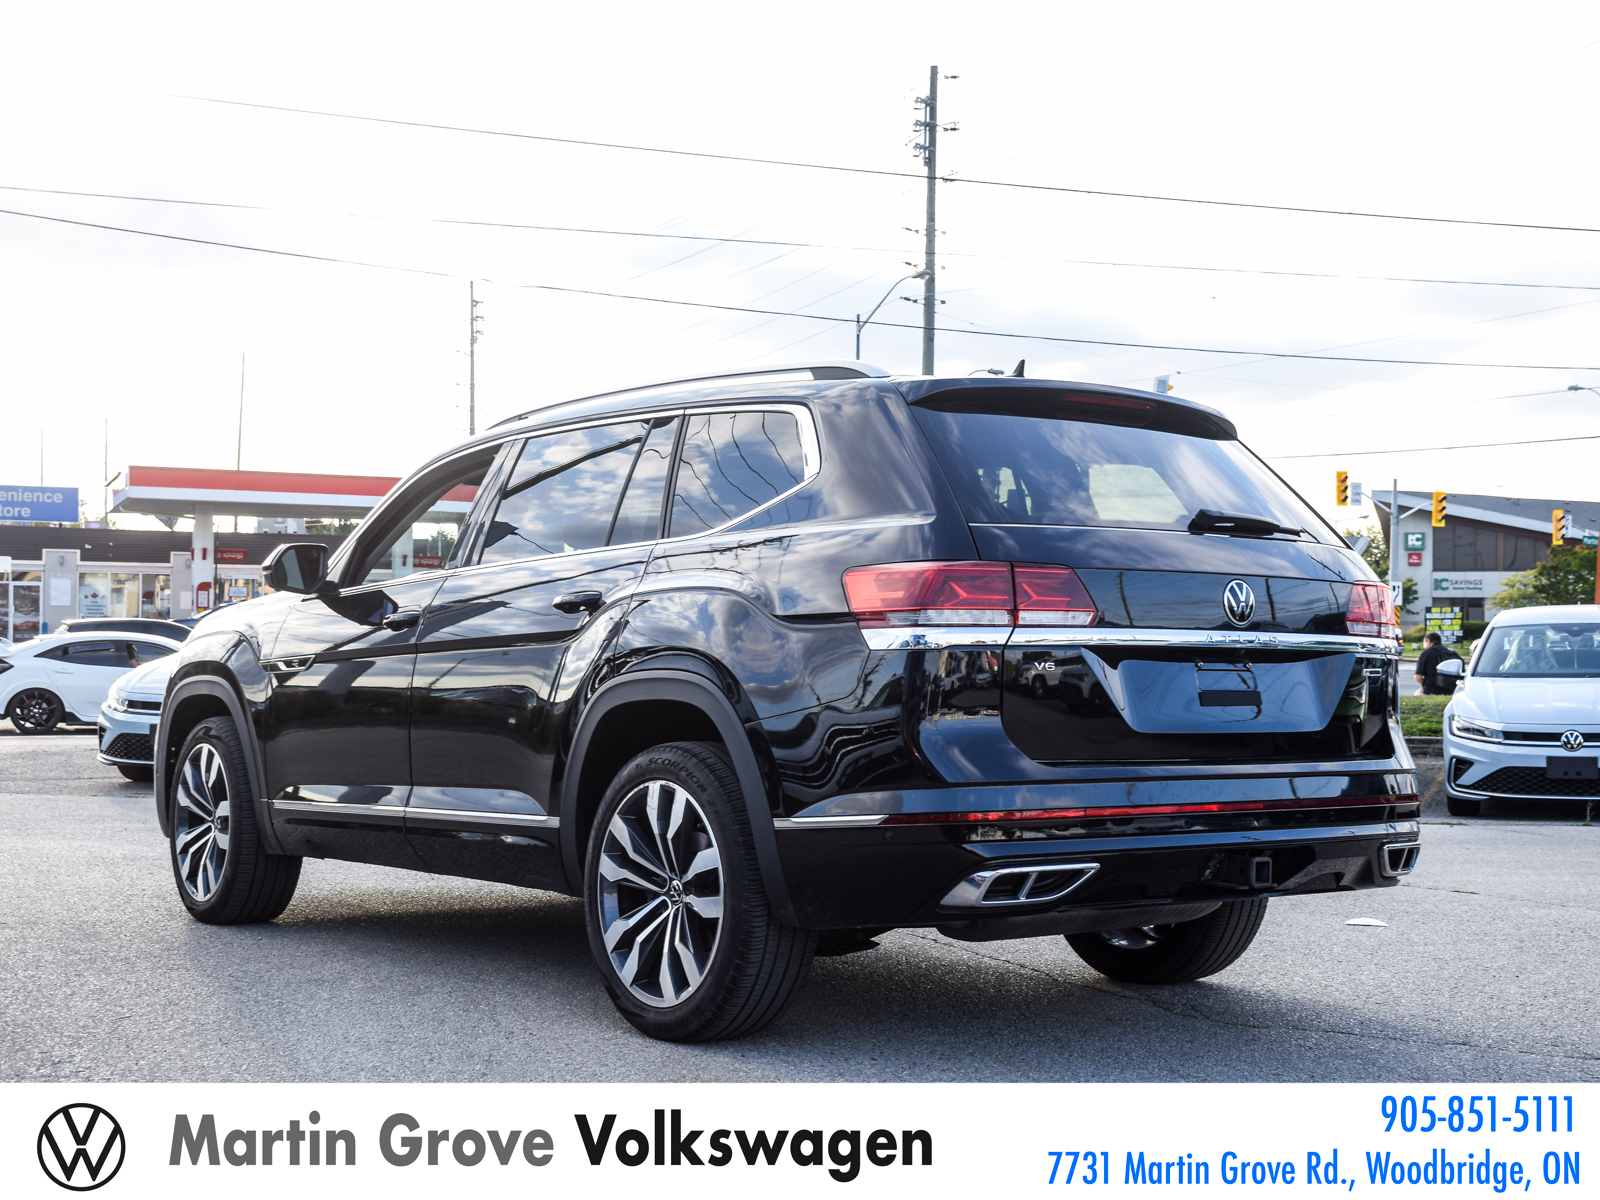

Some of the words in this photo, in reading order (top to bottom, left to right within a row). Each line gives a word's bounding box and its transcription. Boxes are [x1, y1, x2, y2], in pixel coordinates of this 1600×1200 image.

[1205, 633, 1279, 645] ATLAS
[1034, 661, 1055, 671] V6
[646, 757, 708, 794] SCORPION
